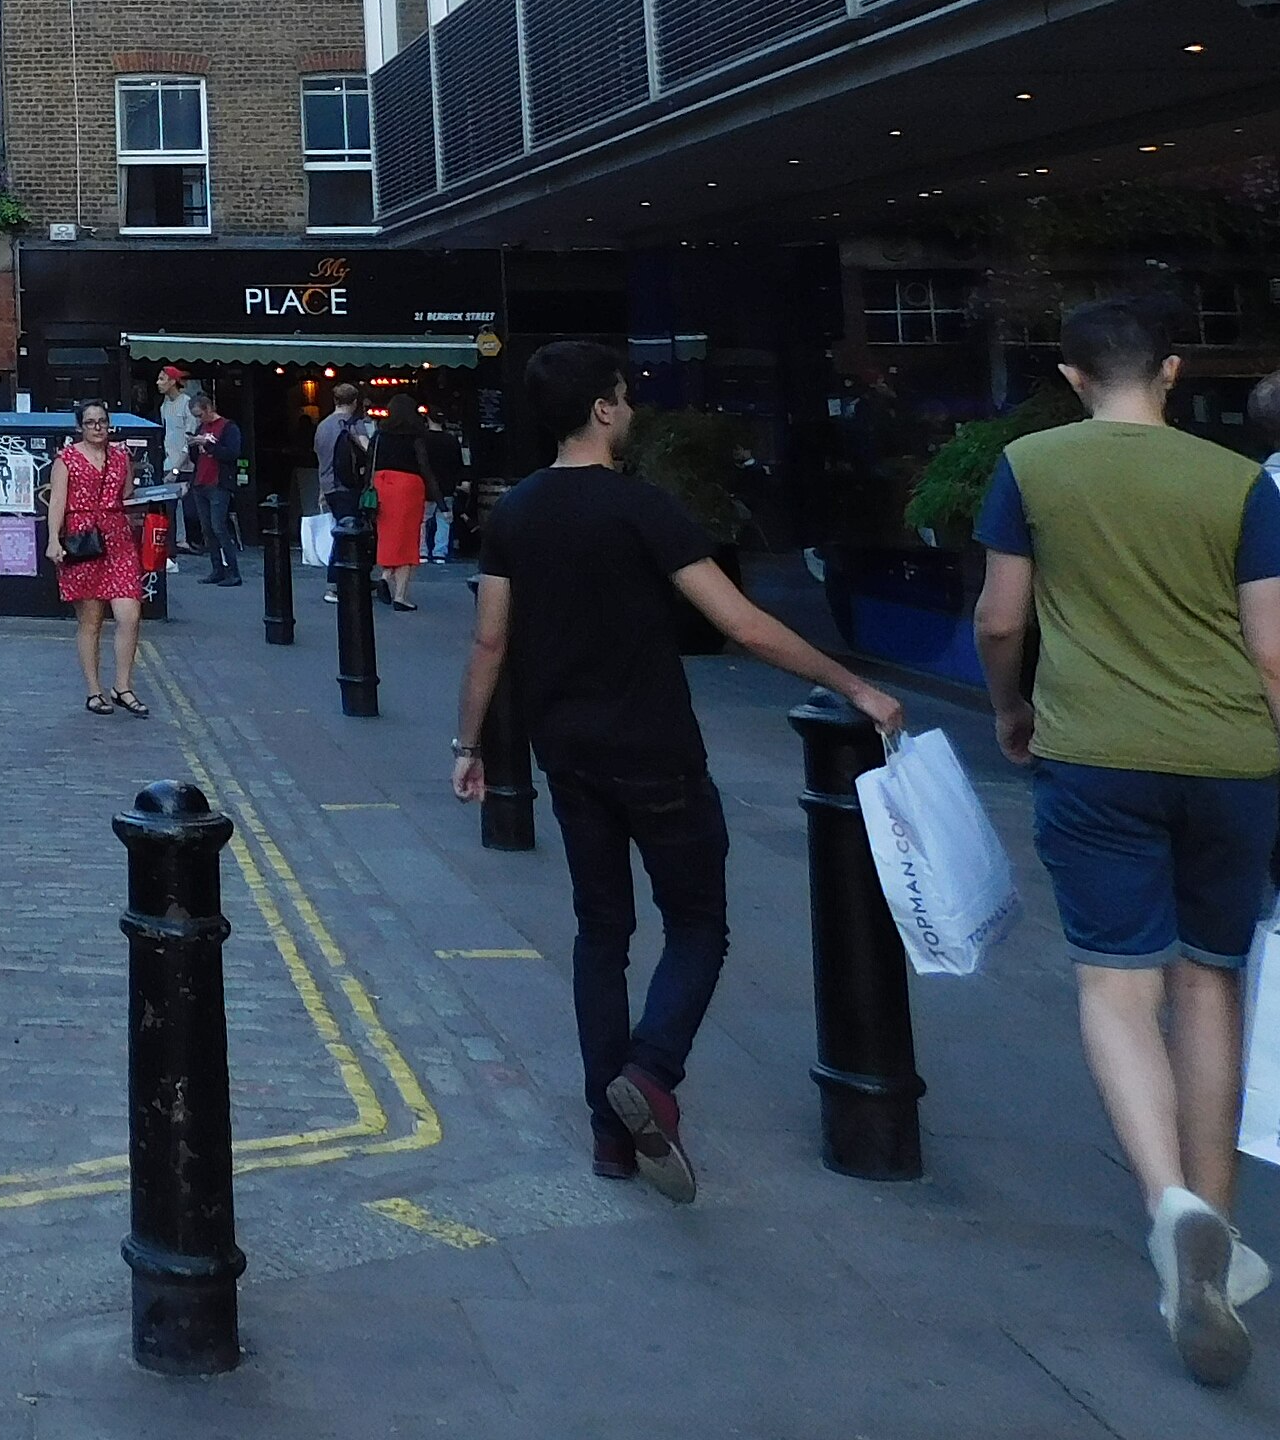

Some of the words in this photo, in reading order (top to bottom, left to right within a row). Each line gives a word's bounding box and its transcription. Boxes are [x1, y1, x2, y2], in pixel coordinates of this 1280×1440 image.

[308, 257, 351, 286] My
[245, 287, 348, 316] PLACE
[464, 312, 496, 322] STREET
